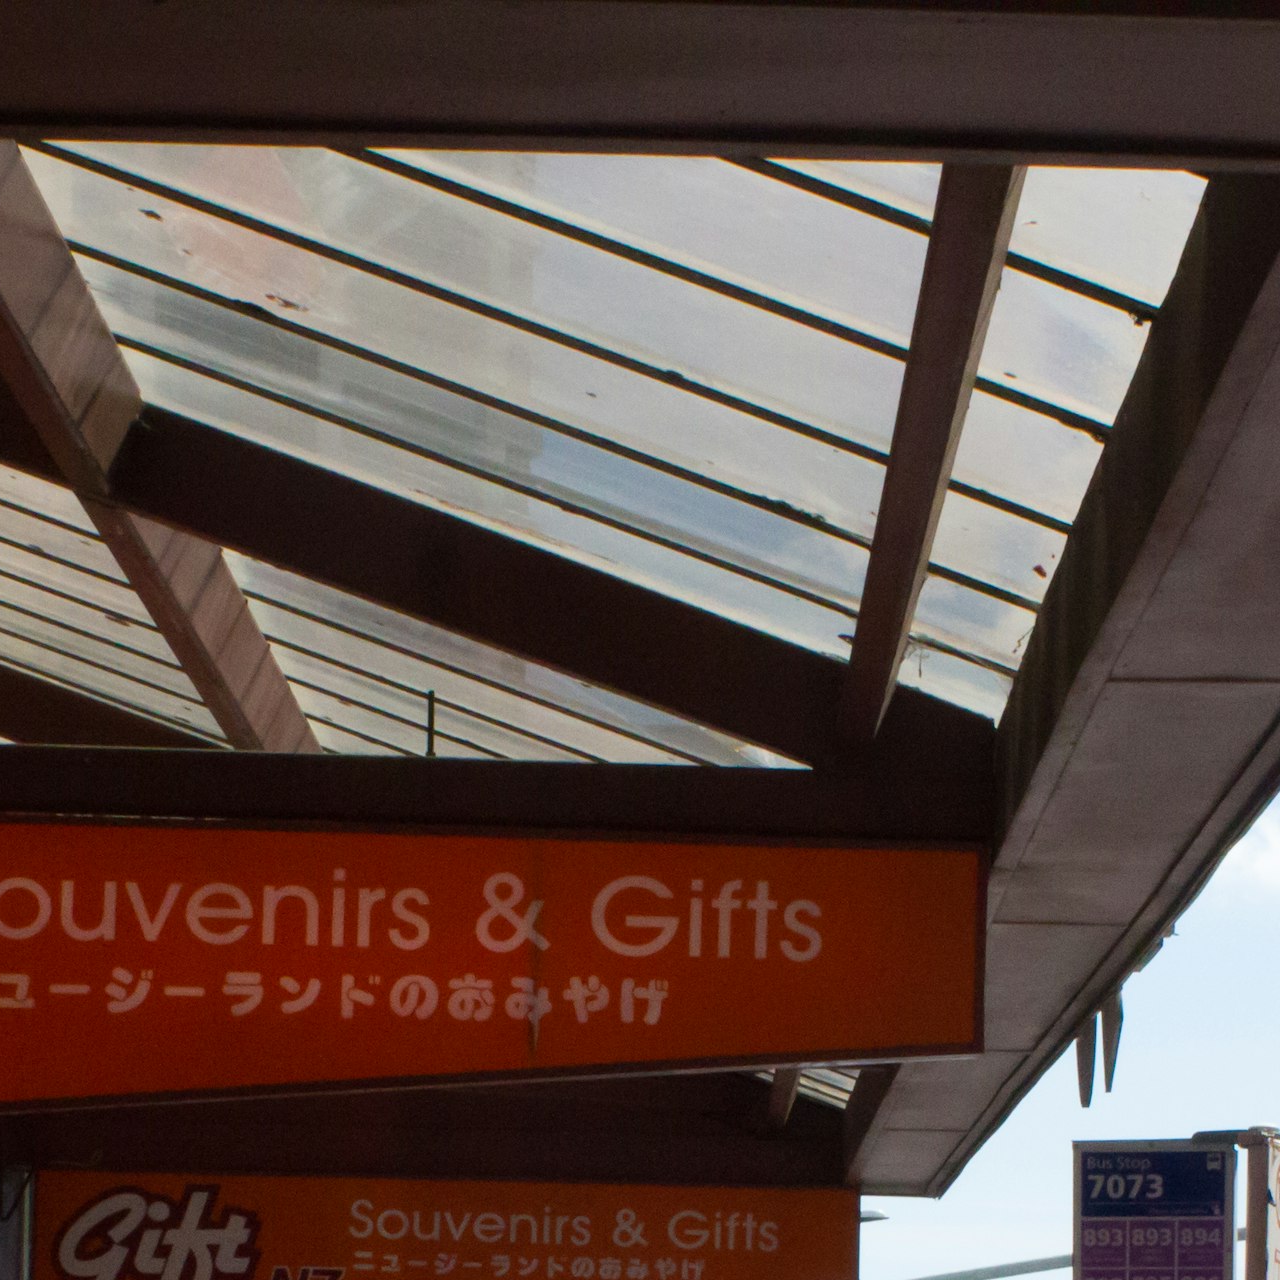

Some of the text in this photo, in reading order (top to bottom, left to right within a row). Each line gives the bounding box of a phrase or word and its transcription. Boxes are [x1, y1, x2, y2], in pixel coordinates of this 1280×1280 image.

[477, 871, 550, 952] &
[590, 874, 824, 963] Gifts
[1087, 1157, 1151, 1171] Bus Stop
[1087, 1174, 1164, 1199] 7073
[349, 1199, 779, 1253] Souvenirs & Gifts
[1083, 1228, 1221, 1247] 893 893 894
